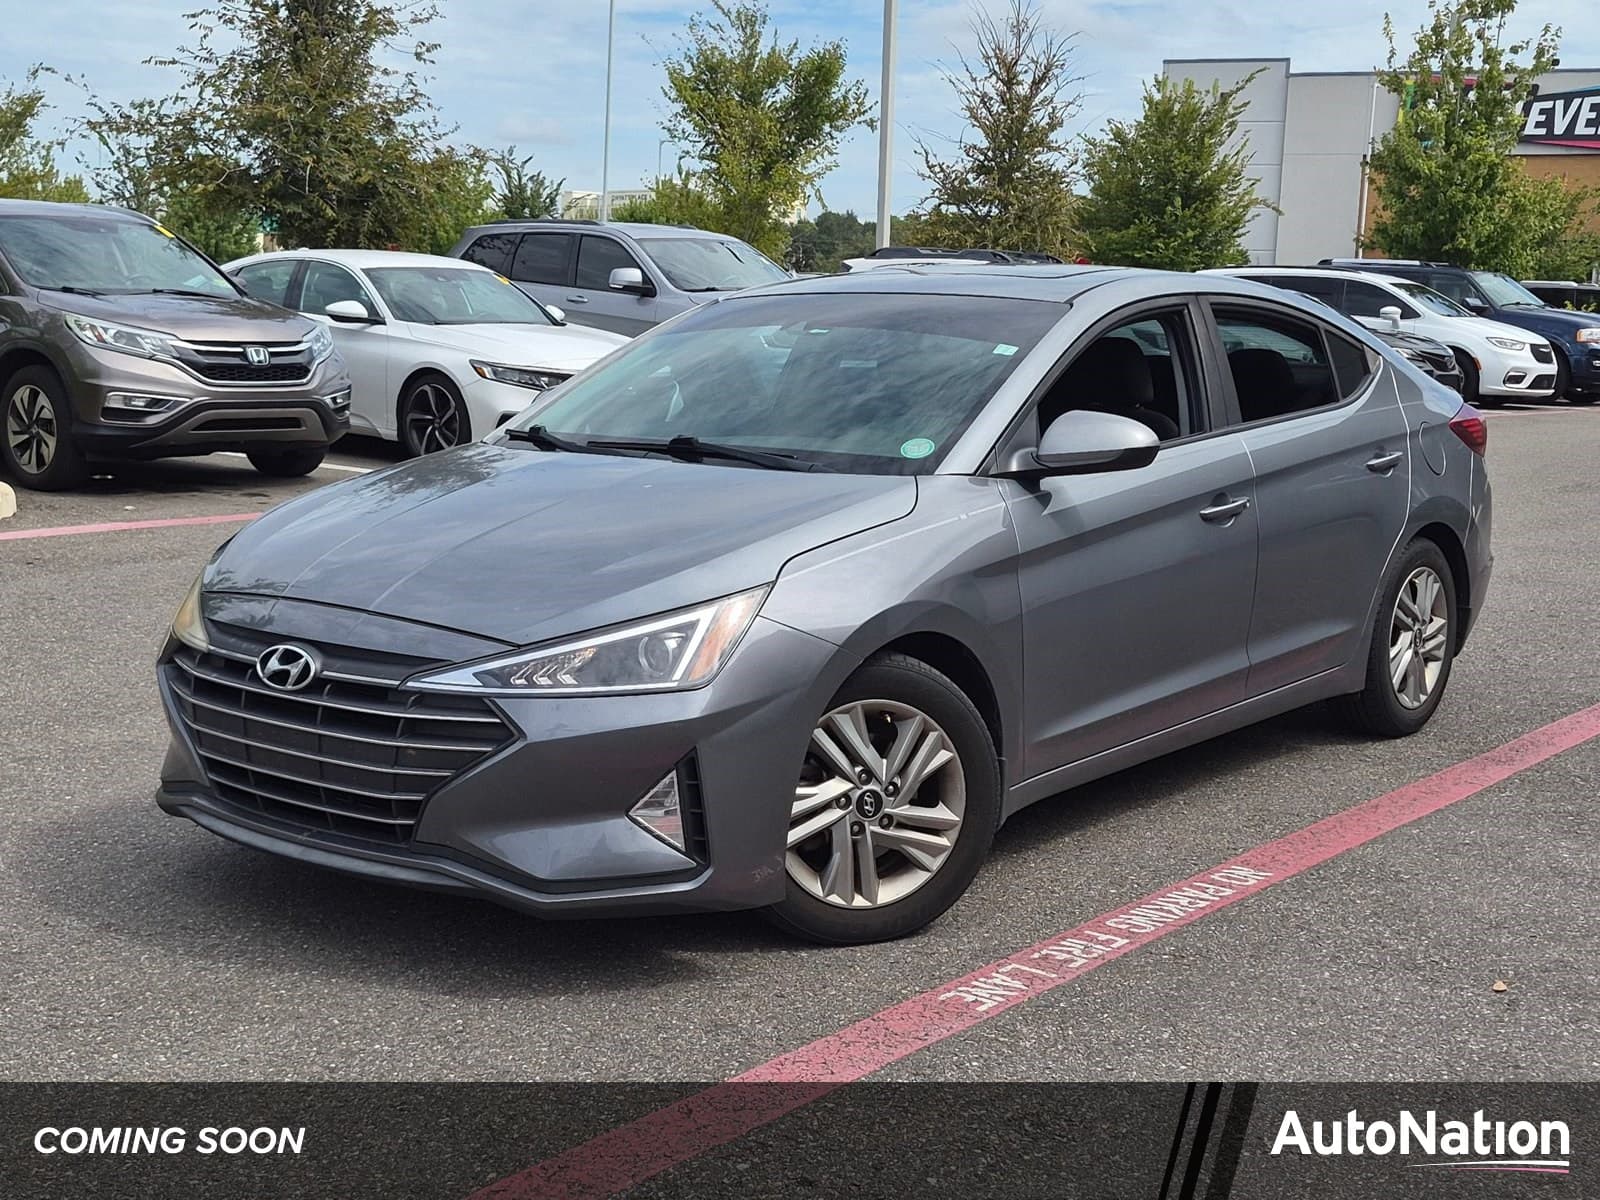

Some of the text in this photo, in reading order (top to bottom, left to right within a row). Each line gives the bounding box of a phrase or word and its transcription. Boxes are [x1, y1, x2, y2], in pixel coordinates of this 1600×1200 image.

[1523, 95, 1600, 136] EVE
[941, 865, 1273, 1012] NO PARKING FIRE LANE
